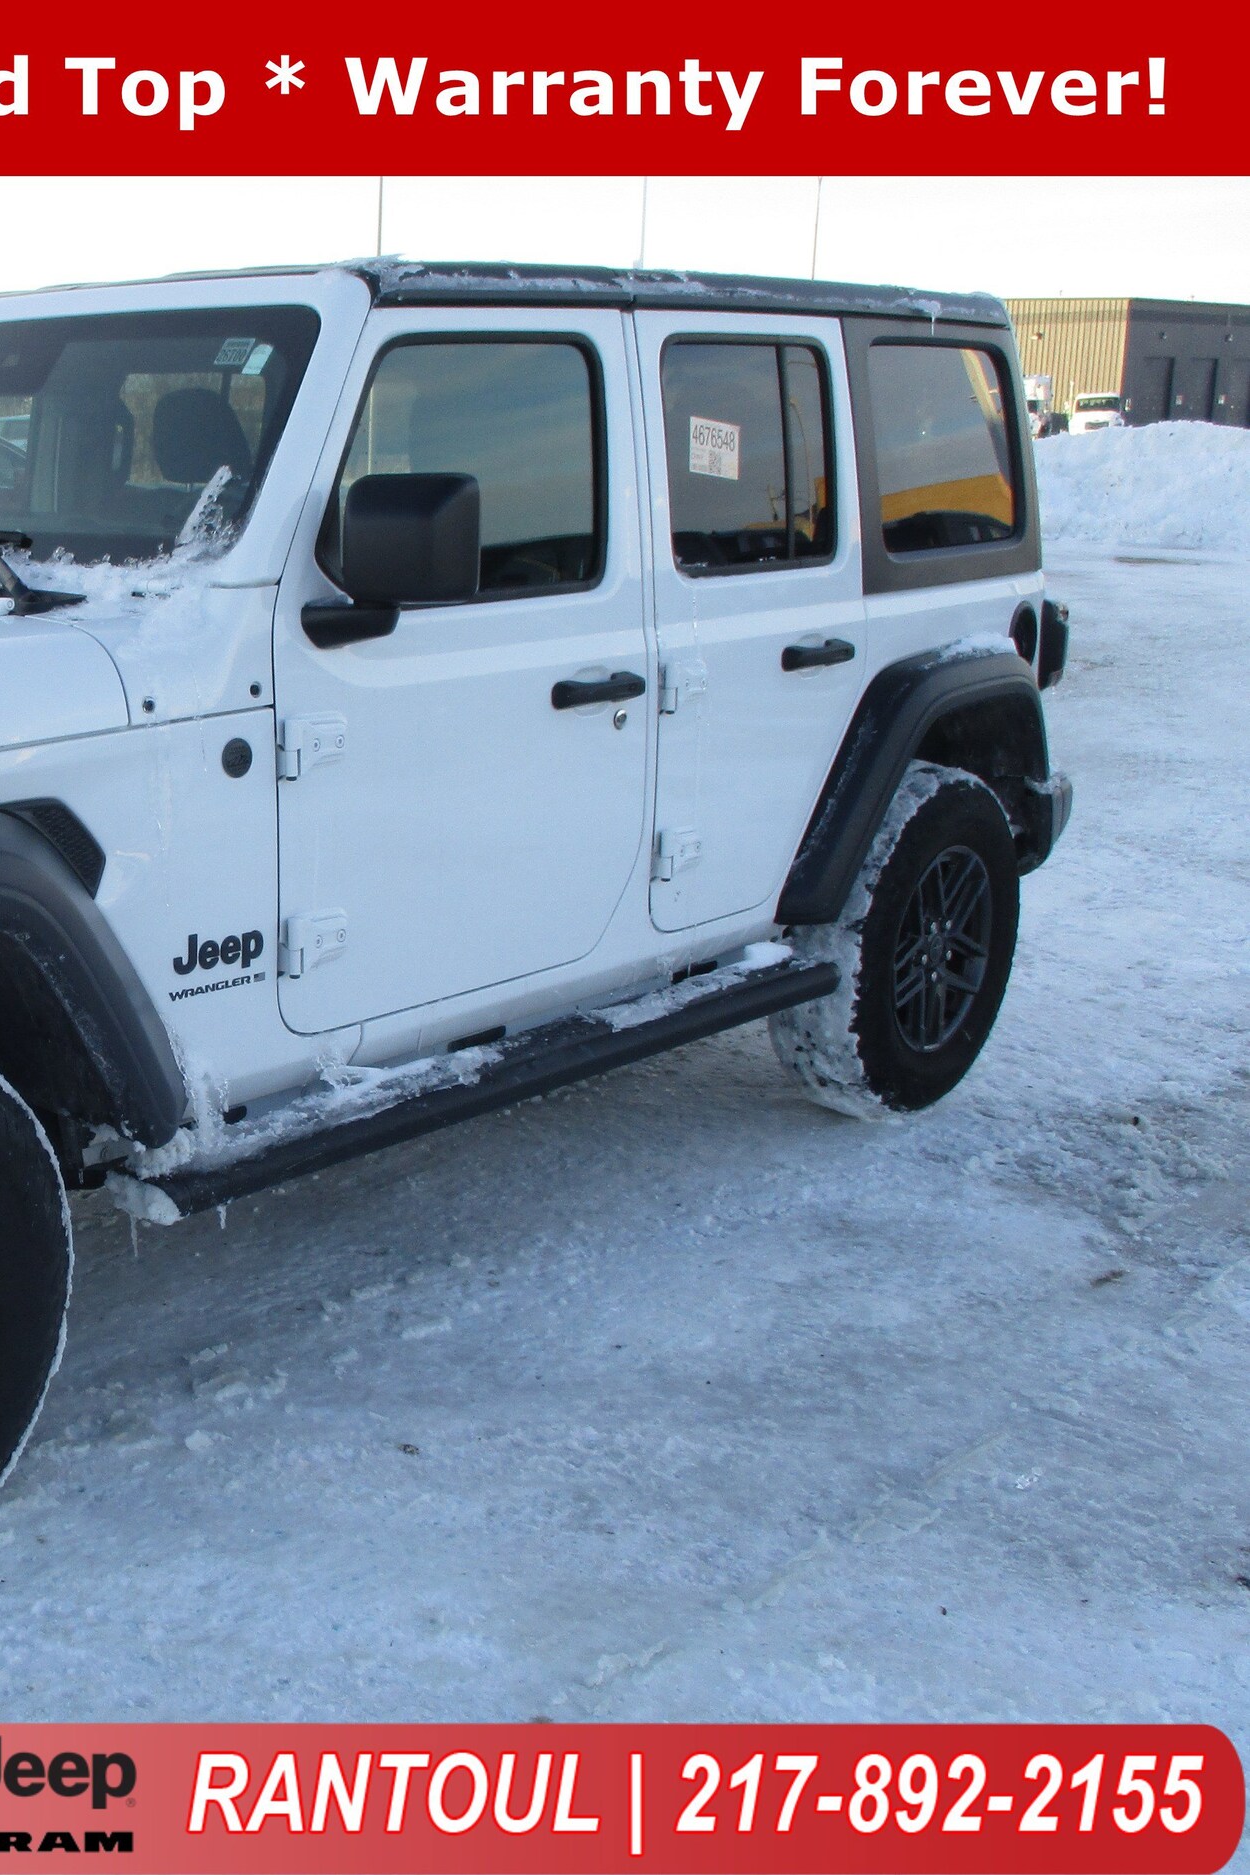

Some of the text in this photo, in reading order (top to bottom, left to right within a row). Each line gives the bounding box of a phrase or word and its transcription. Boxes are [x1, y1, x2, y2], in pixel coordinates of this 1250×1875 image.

[692, 424, 735, 452] 4676548
[173, 930, 264, 975] Jeep
[169, 975, 251, 1001] WRANGLER
